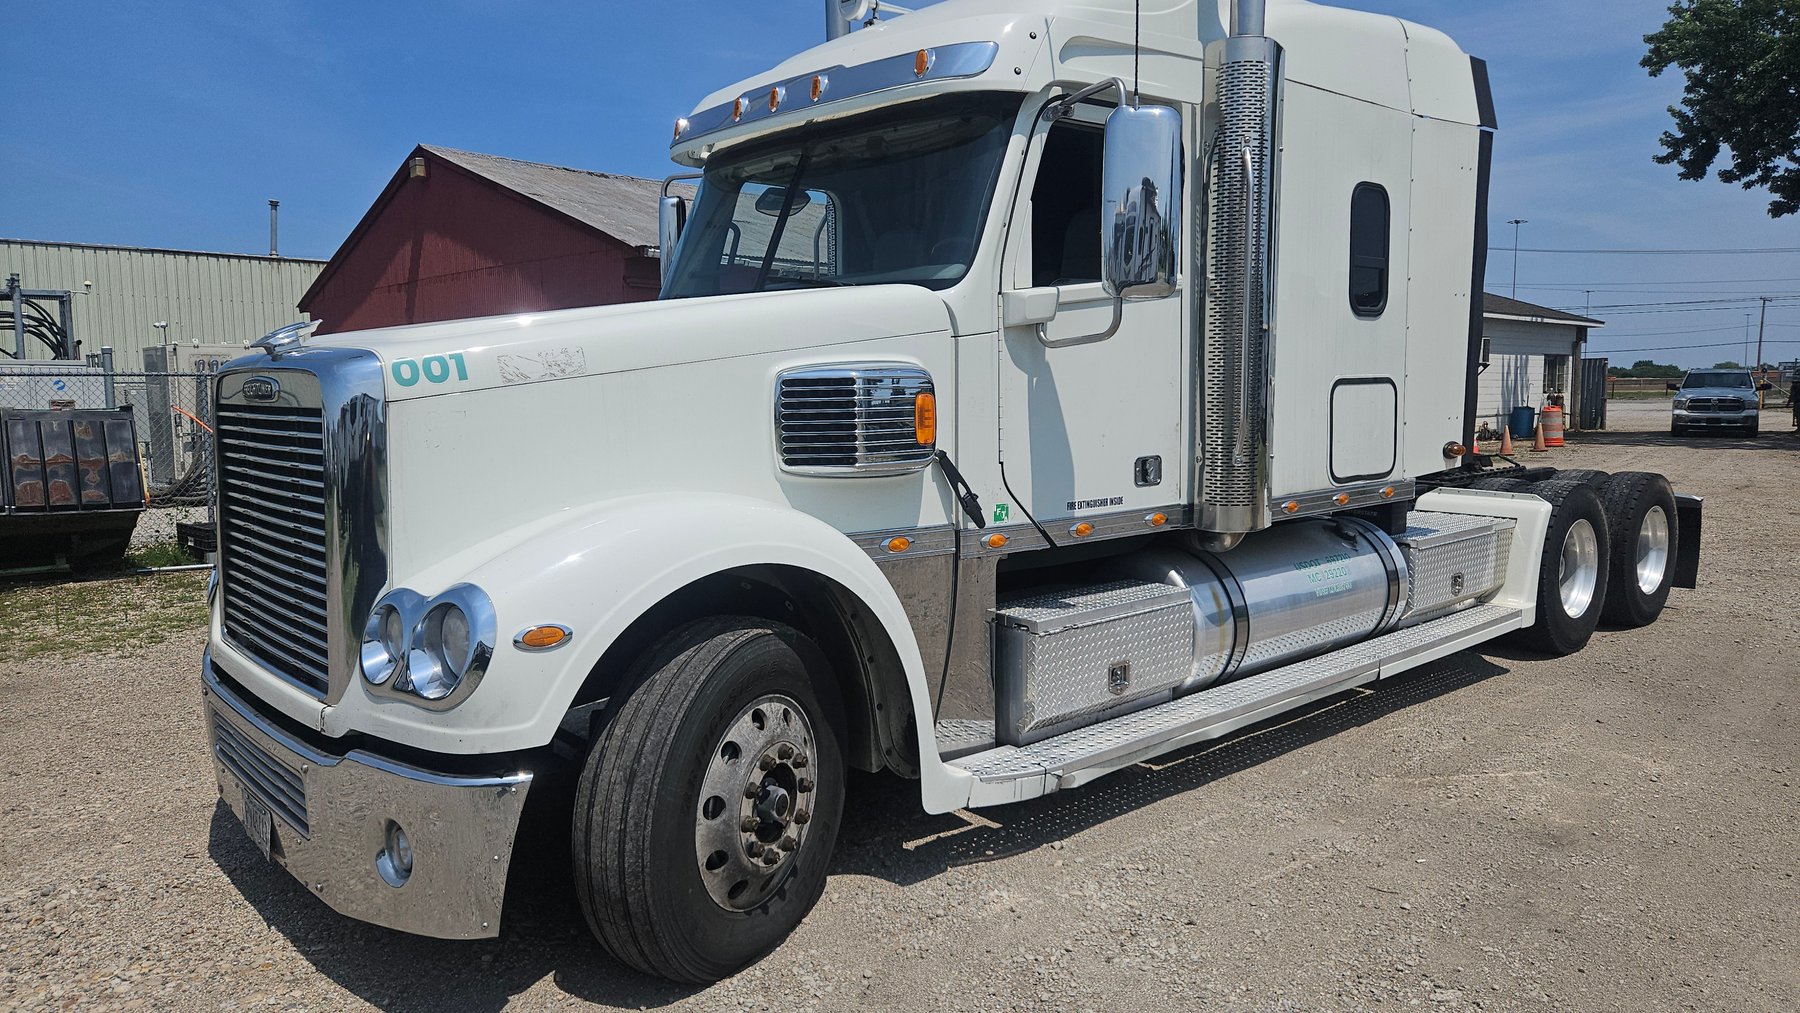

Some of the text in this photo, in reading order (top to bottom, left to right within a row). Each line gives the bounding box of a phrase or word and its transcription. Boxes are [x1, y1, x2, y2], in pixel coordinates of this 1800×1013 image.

[391, 353, 469, 388] 001
[1067, 496, 1124, 511] FIRE EXTINGUISHER INSIDE
[1293, 560, 1321, 571] USDOT
[1308, 565, 1350, 584] MC 29220
